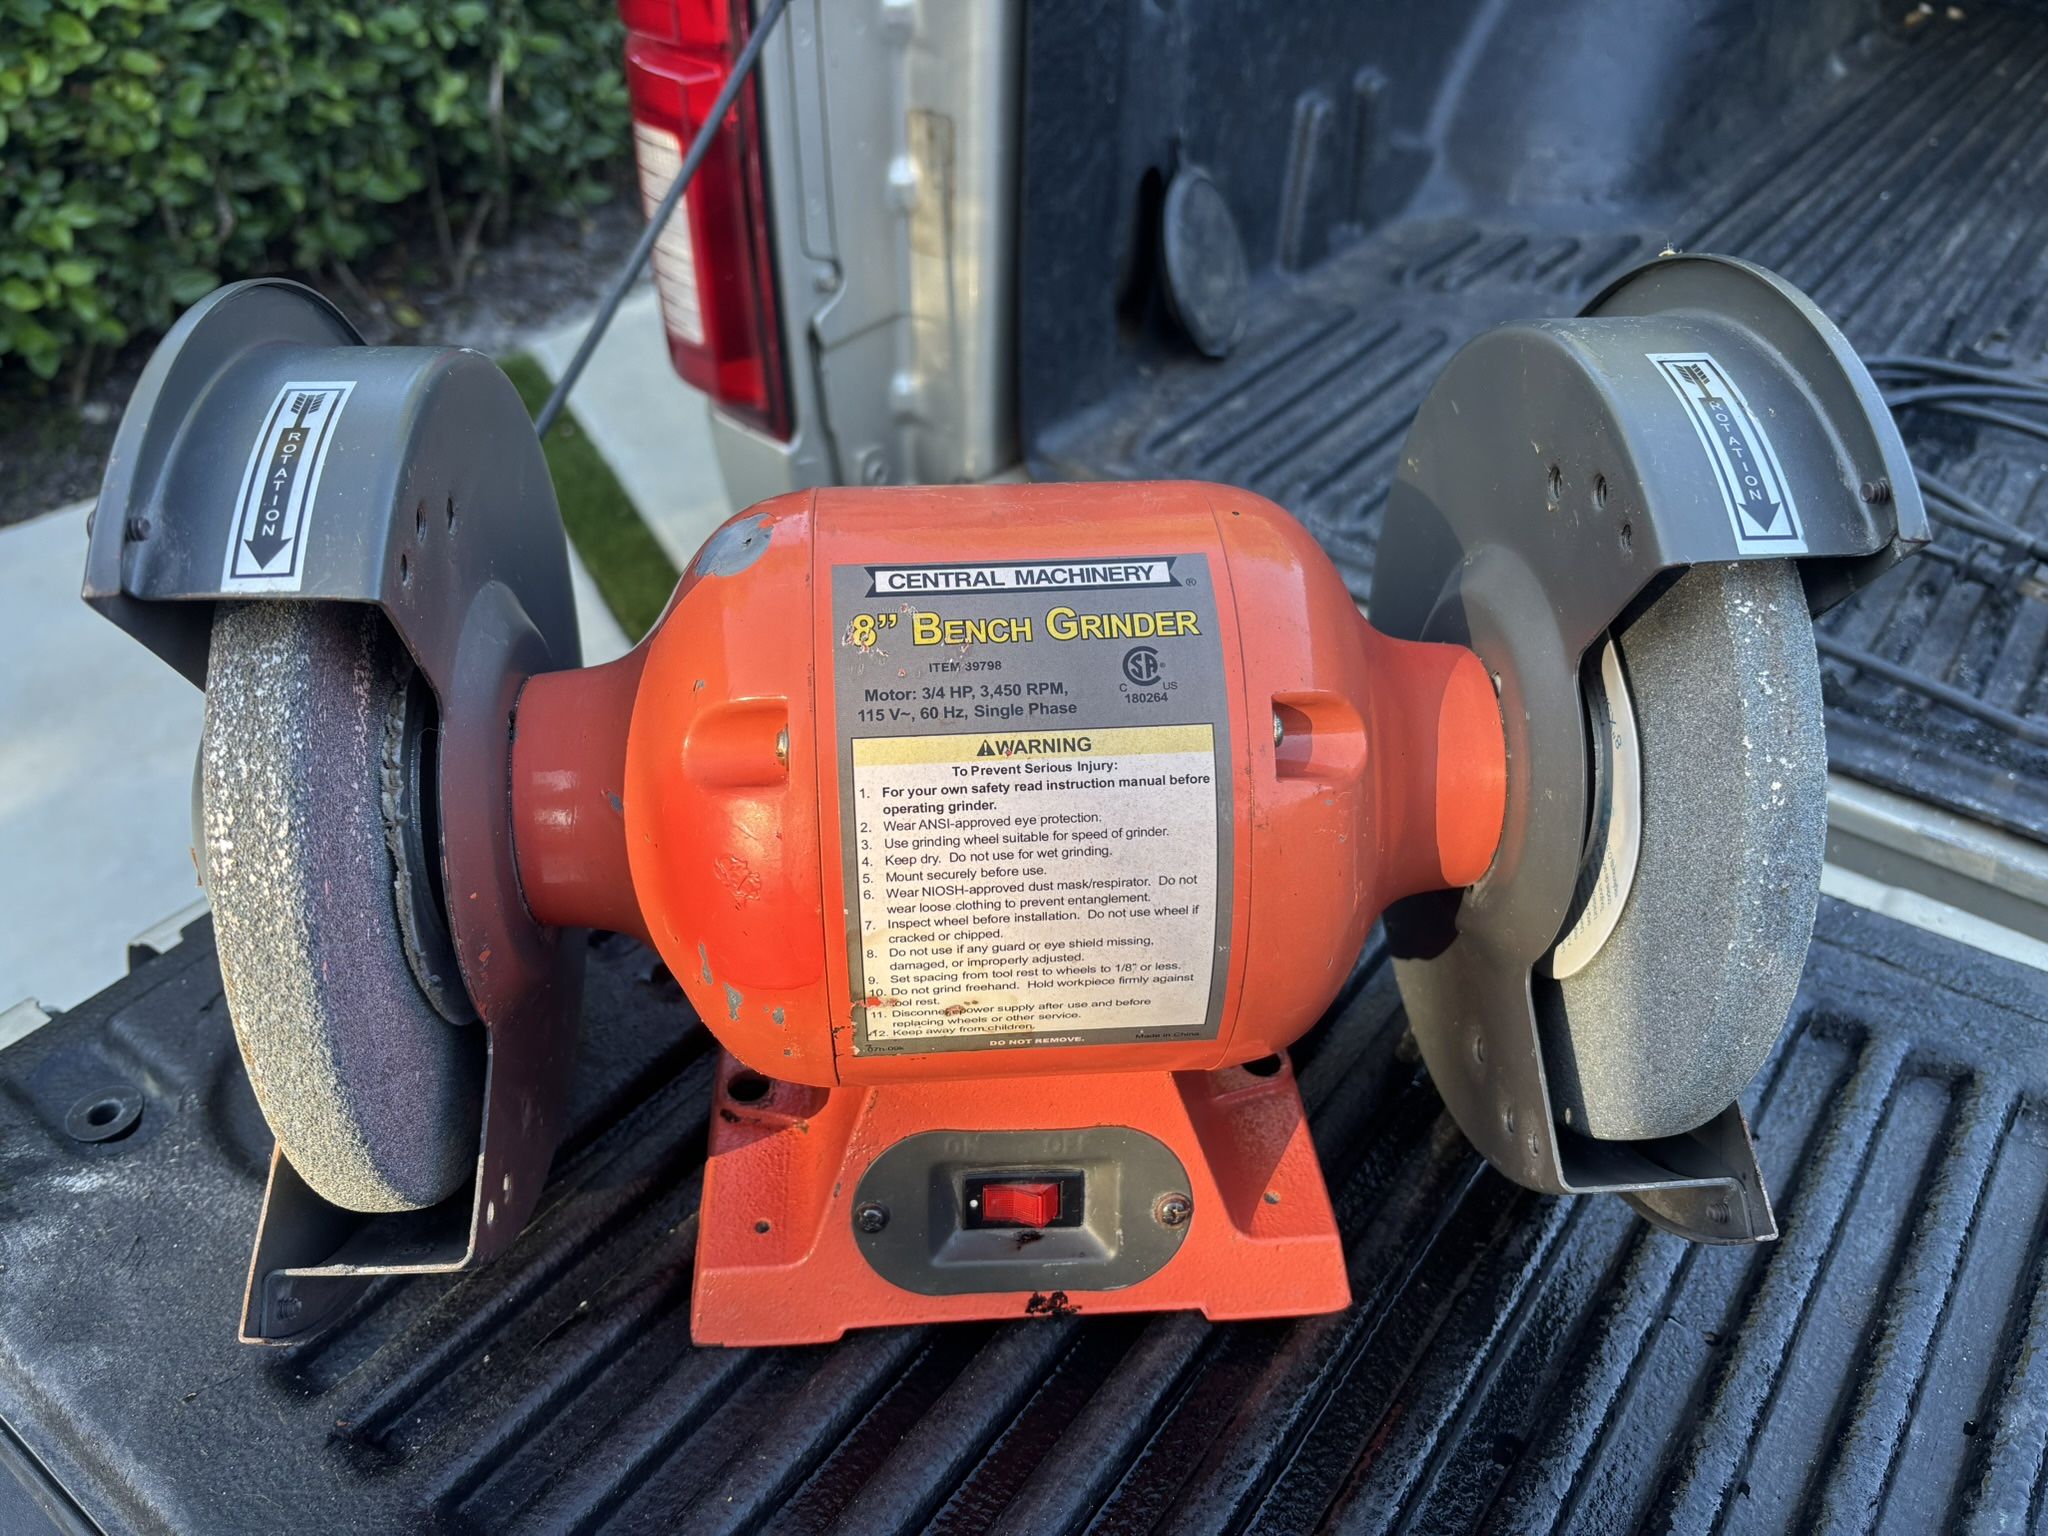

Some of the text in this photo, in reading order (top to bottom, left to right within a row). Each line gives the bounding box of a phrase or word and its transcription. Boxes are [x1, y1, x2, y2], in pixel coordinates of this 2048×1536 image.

[1709, 401, 1762, 501] ROTATION
[261, 432, 301, 536] ROTATION
[888, 564, 1153, 589] CENTRAL MACHINERY
[912, 612, 1033, 646] BENCH
[1045, 606, 1202, 640] GRINDER
[929, 660, 1002, 673] ITEM 39798
[864, 681, 1068, 702] Motor: 3/4 HP, 3,450 RPM,
[1162, 681, 1178, 690] US
[1124, 692, 1169, 703] 180264
[857, 708, 885, 722] 115
[919, 706, 938, 720] 60
[943, 705, 968, 720] Hz,
[974, 703, 1024, 720] Single
[1028, 701, 1077, 715] Phase
[996, 737, 1091, 755] WARNING
[951, 760, 1117, 776] To Prevent Serious Injury:
[859, 773, 1210, 799] 1. For your own safety read instruction manual before
[882, 799, 997, 817] operating grinder.
[860, 822, 871, 833] 2.
[882, 816, 916, 831] Wear
[918, 815, 1011, 831] ANSI-approved
[1014, 816, 1037, 828] eye
[861, 825, 1169, 850] 3. Use grinding wheel suitable for speed of grinder.
[861, 845, 1112, 867] 4. Keep dry. Do not use for wet grinding.
[862, 866, 1046, 883] 5. Mount securely before use.
[863, 874, 1197, 900] 6. Wear NIOSH-approved dust mask/respirator. Do not
[886, 892, 1150, 914] wear loose clothing to prevent entanglement.
[864, 904, 1199, 930] 7. Inspect wheel before installation. Do not use wheel if
[888, 928, 1003, 943] cracked or chipped.
[866, 935, 1154, 958] 8. Do not use if any guard or eye shield missing,
[889, 959, 948, 971] damaged,
[967, 955, 1029, 968] improperly
[1031, 952, 1084, 965] adjusted.
[868, 976, 879, 985] 9.
[890, 974, 910, 983] Set
[913, 972, 958, 983] spacing
[962, 970, 988, 980] from
[991, 968, 1013, 978] tool
[1016, 967, 1038, 977] rest
[1041, 967, 1053, 976] to
[1055, 965, 1096, 975] wheels
[1100, 964, 1111, 973] to
[1139, 963, 1152, 971] or
[1155, 961, 1181, 970] less.
[869, 973, 1194, 997] 10. Do not grind freehand. Hold workpiece firmly against
[891, 997, 939, 1007] ool rest.
[997, 1003, 1035, 1013] supply
[1038, 1001, 1063, 1010] after
[1067, 1001, 1088, 1009] use
[1091, 999, 1112, 1007] and
[1115, 998, 1151, 1006] before
[892, 1018, 944, 1028] replacing
[947, 1015, 987, 1024] wheels
[1038, 1011, 1081, 1020] service.
[892, 1029, 923, 1037] Keep
[926, 1028, 955, 1036] away
[986, 1023, 1036, 1032] children.
[1034, 1036, 1084, 1044] REMOVE.
